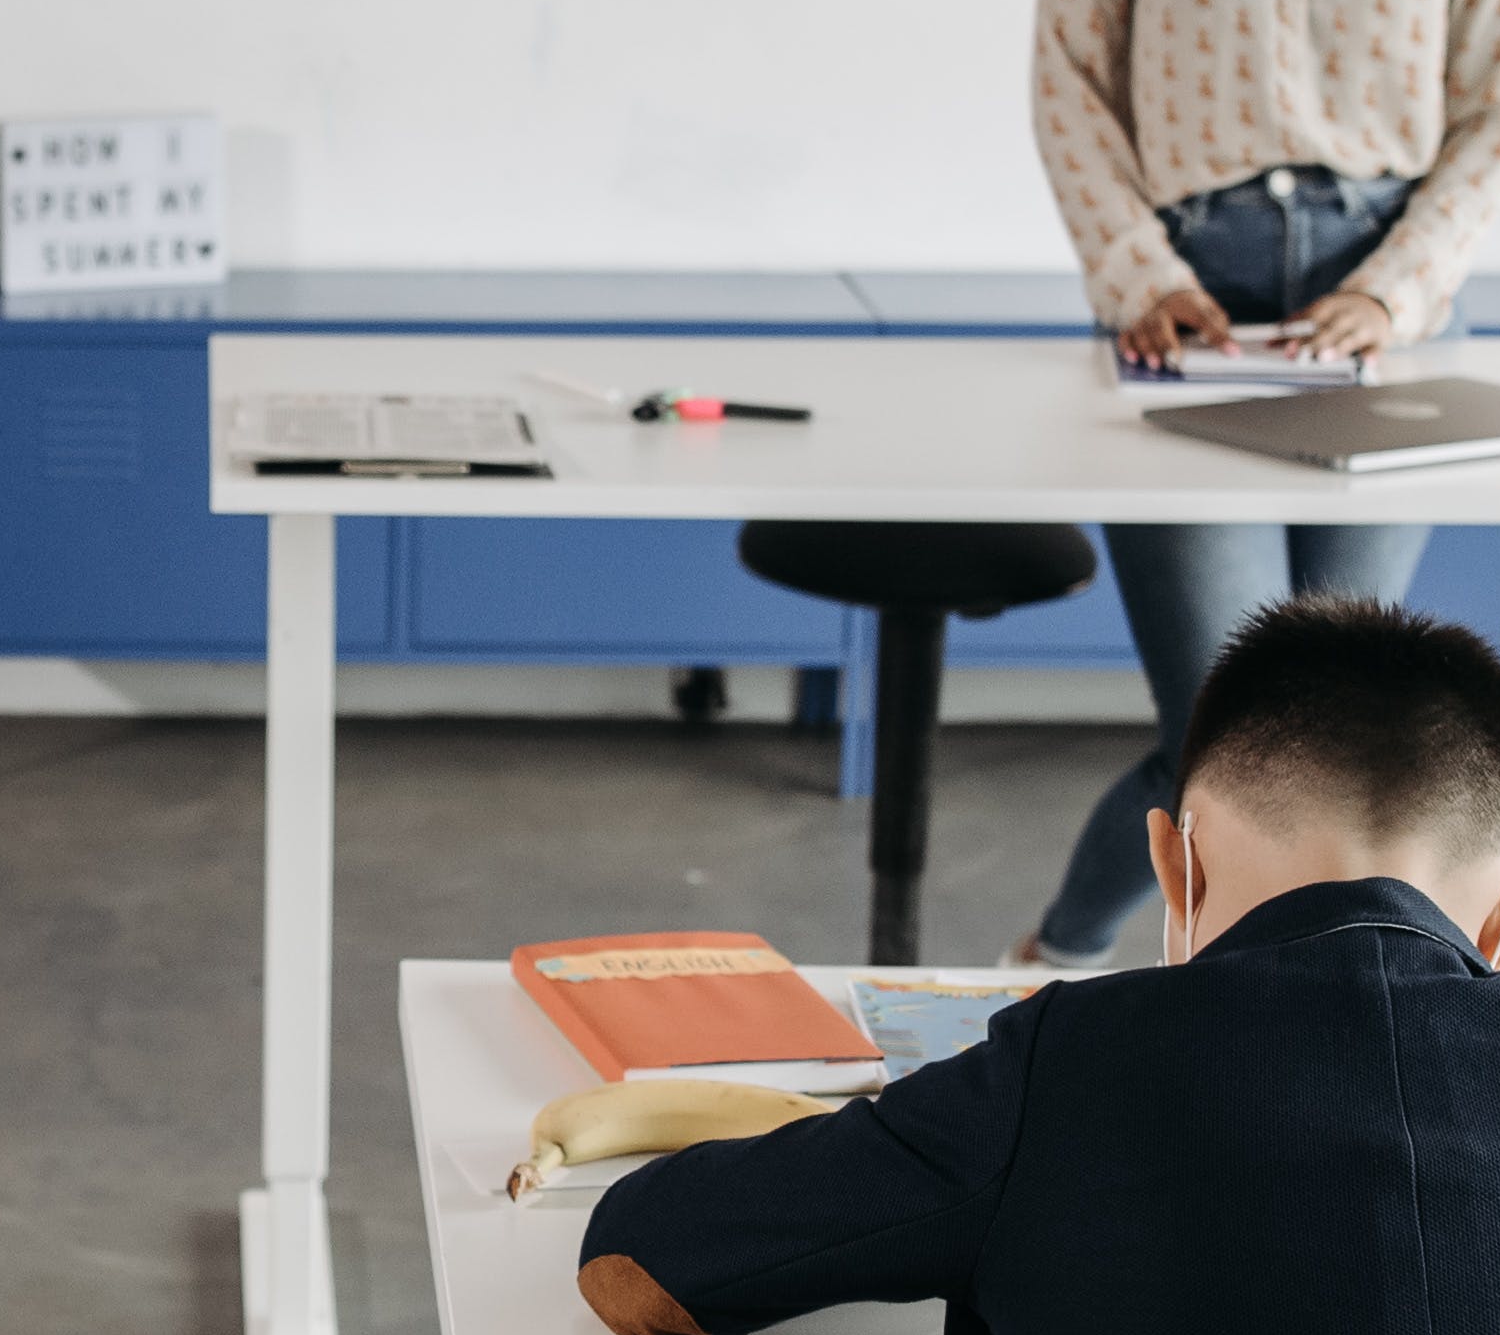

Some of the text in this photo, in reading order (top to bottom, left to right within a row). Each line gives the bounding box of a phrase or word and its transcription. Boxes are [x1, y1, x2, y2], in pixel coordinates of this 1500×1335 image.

[42, 135, 118, 169] HOW
[12, 183, 131, 224] SPENT
[44, 237, 186, 274] SUMMER
[599, 953, 736, 974] ENGLISH
